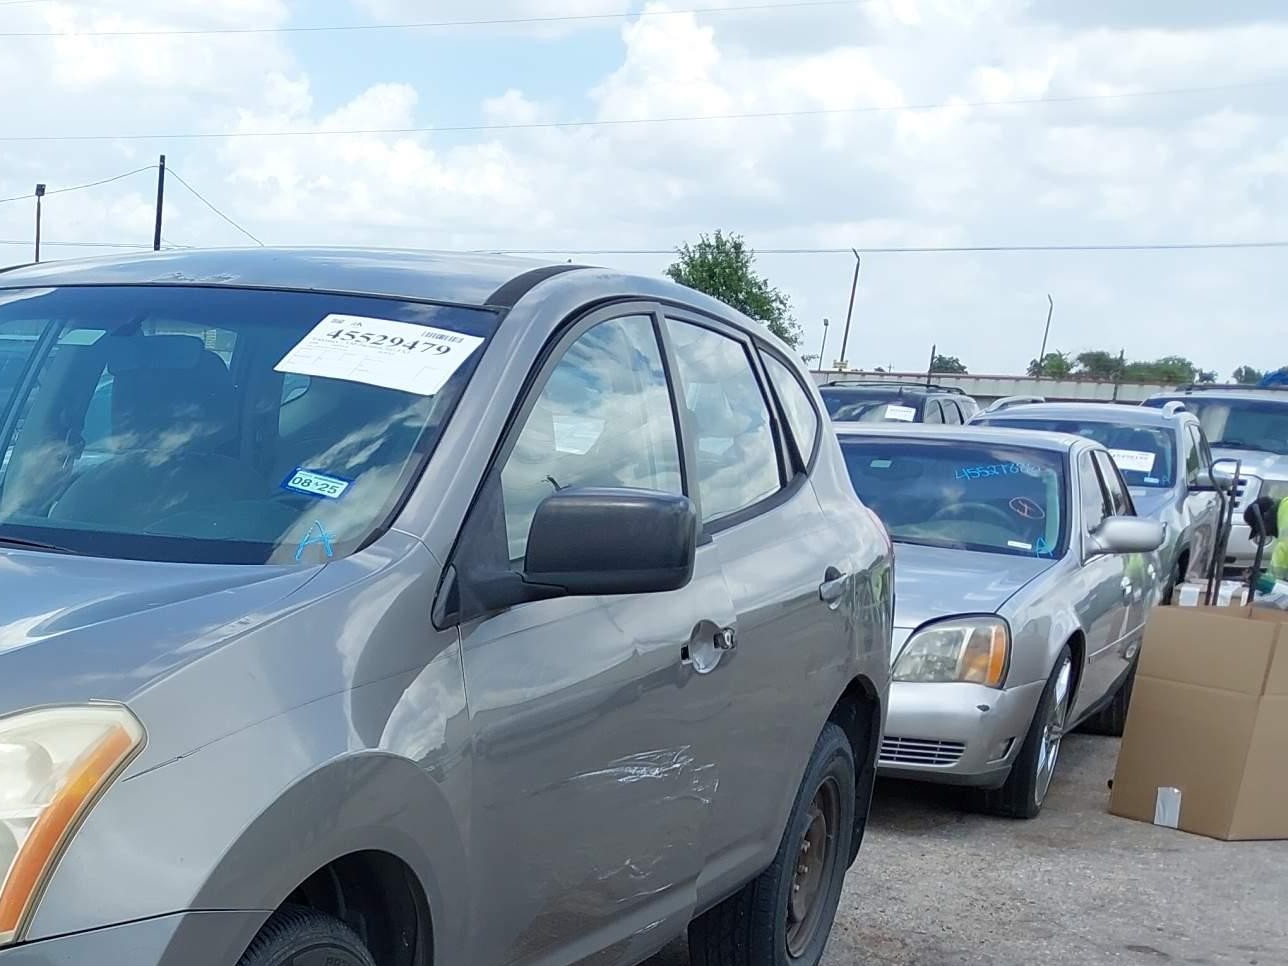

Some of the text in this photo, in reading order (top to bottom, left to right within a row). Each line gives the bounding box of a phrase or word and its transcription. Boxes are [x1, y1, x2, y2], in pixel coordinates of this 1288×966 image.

[326, 328, 451, 356] 45529479
[292, 476, 340, 494] 08 25
